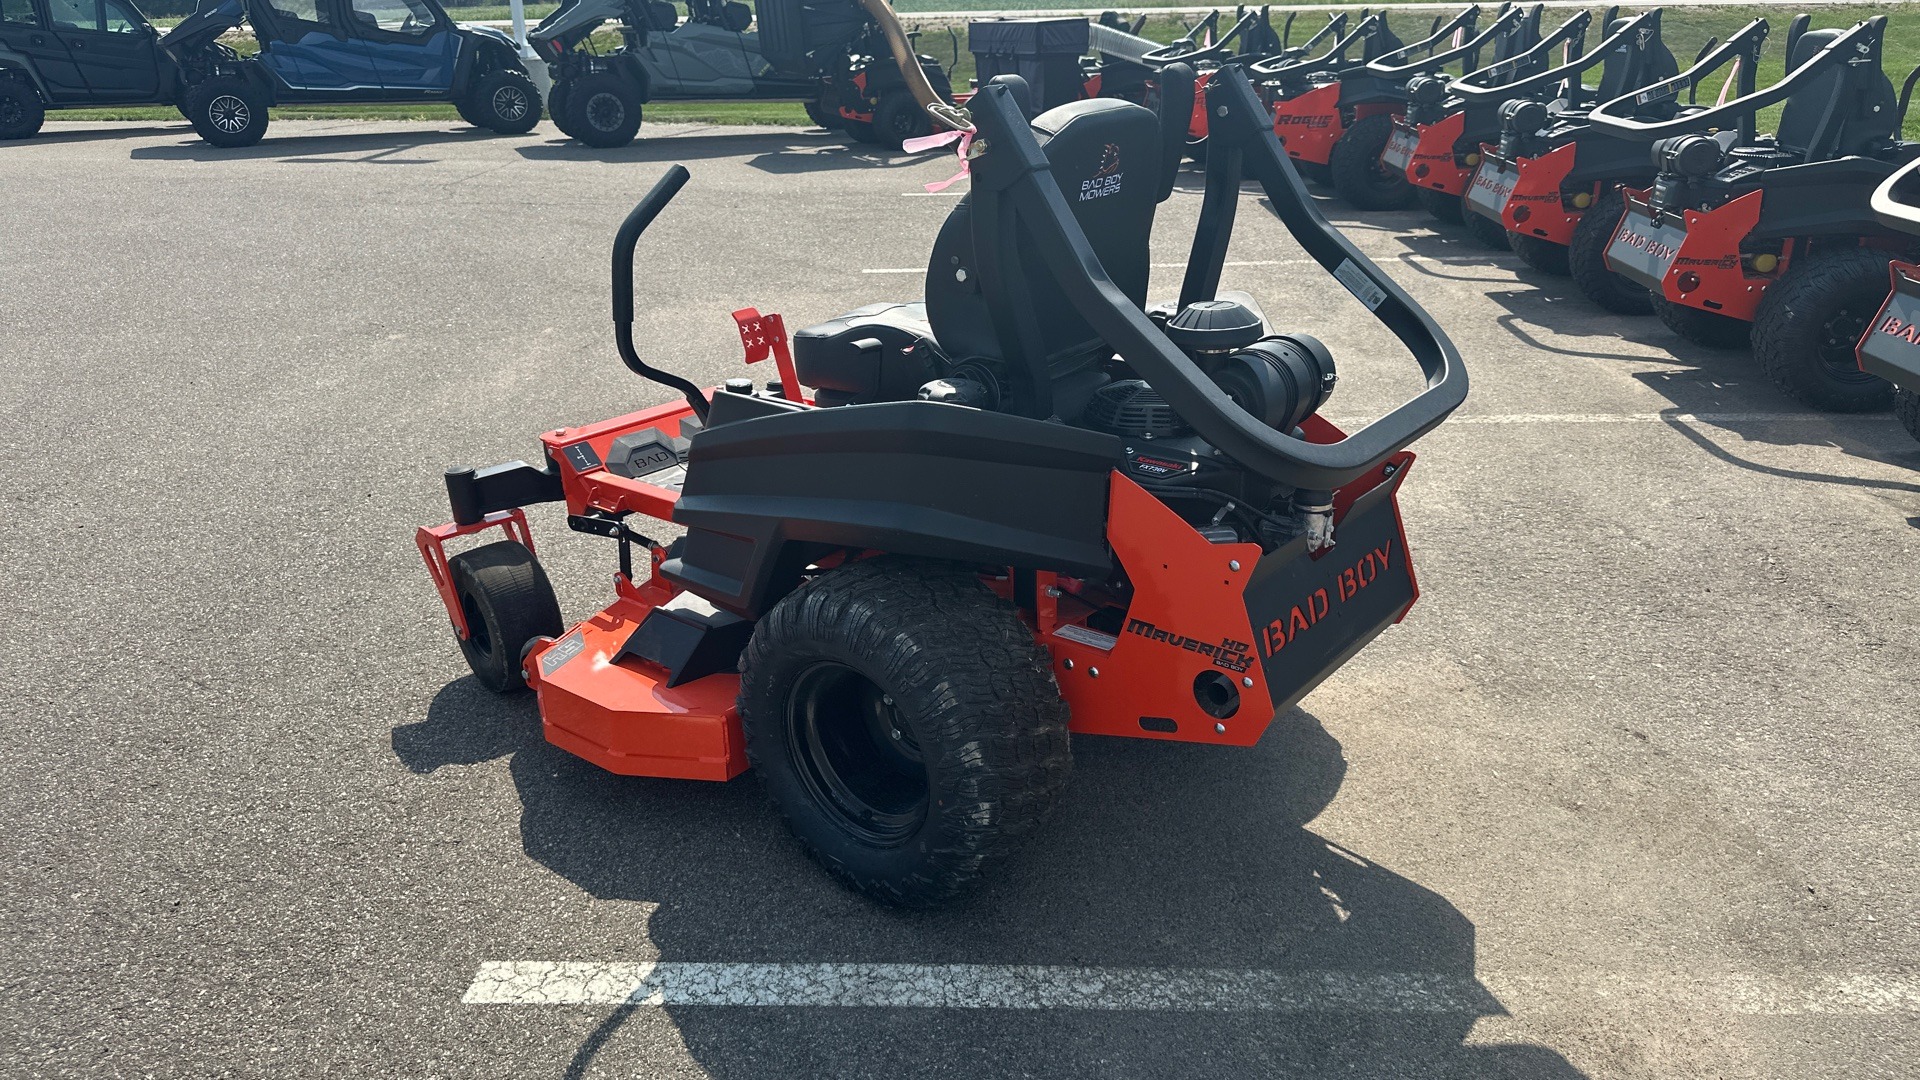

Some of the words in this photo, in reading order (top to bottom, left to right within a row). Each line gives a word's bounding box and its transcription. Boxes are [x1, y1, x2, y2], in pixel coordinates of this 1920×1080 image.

[1277, 114, 1333, 125] ROGUE
[1082, 178, 1103, 190] BAD
[1105, 173, 1123, 186] BOY
[1476, 176, 1493, 190] BAD
[1079, 183, 1121, 201] MOWERS
[1618, 228, 1646, 249] BAD
[1645, 239, 1676, 260] BOY
[1675, 257, 1739, 268] MAVERICK
[634, 451, 669, 469] BAD
[1137, 456, 1183, 470] Kawasaki
[1262, 587, 1330, 659] BAD
[1337, 539, 1392, 603] BOY
[1126, 617, 1255, 668] MAVERICK
[1221, 637, 1249, 653] HD
[1215, 660, 1229, 668] BAD
[1230, 664, 1244, 672] BOY
